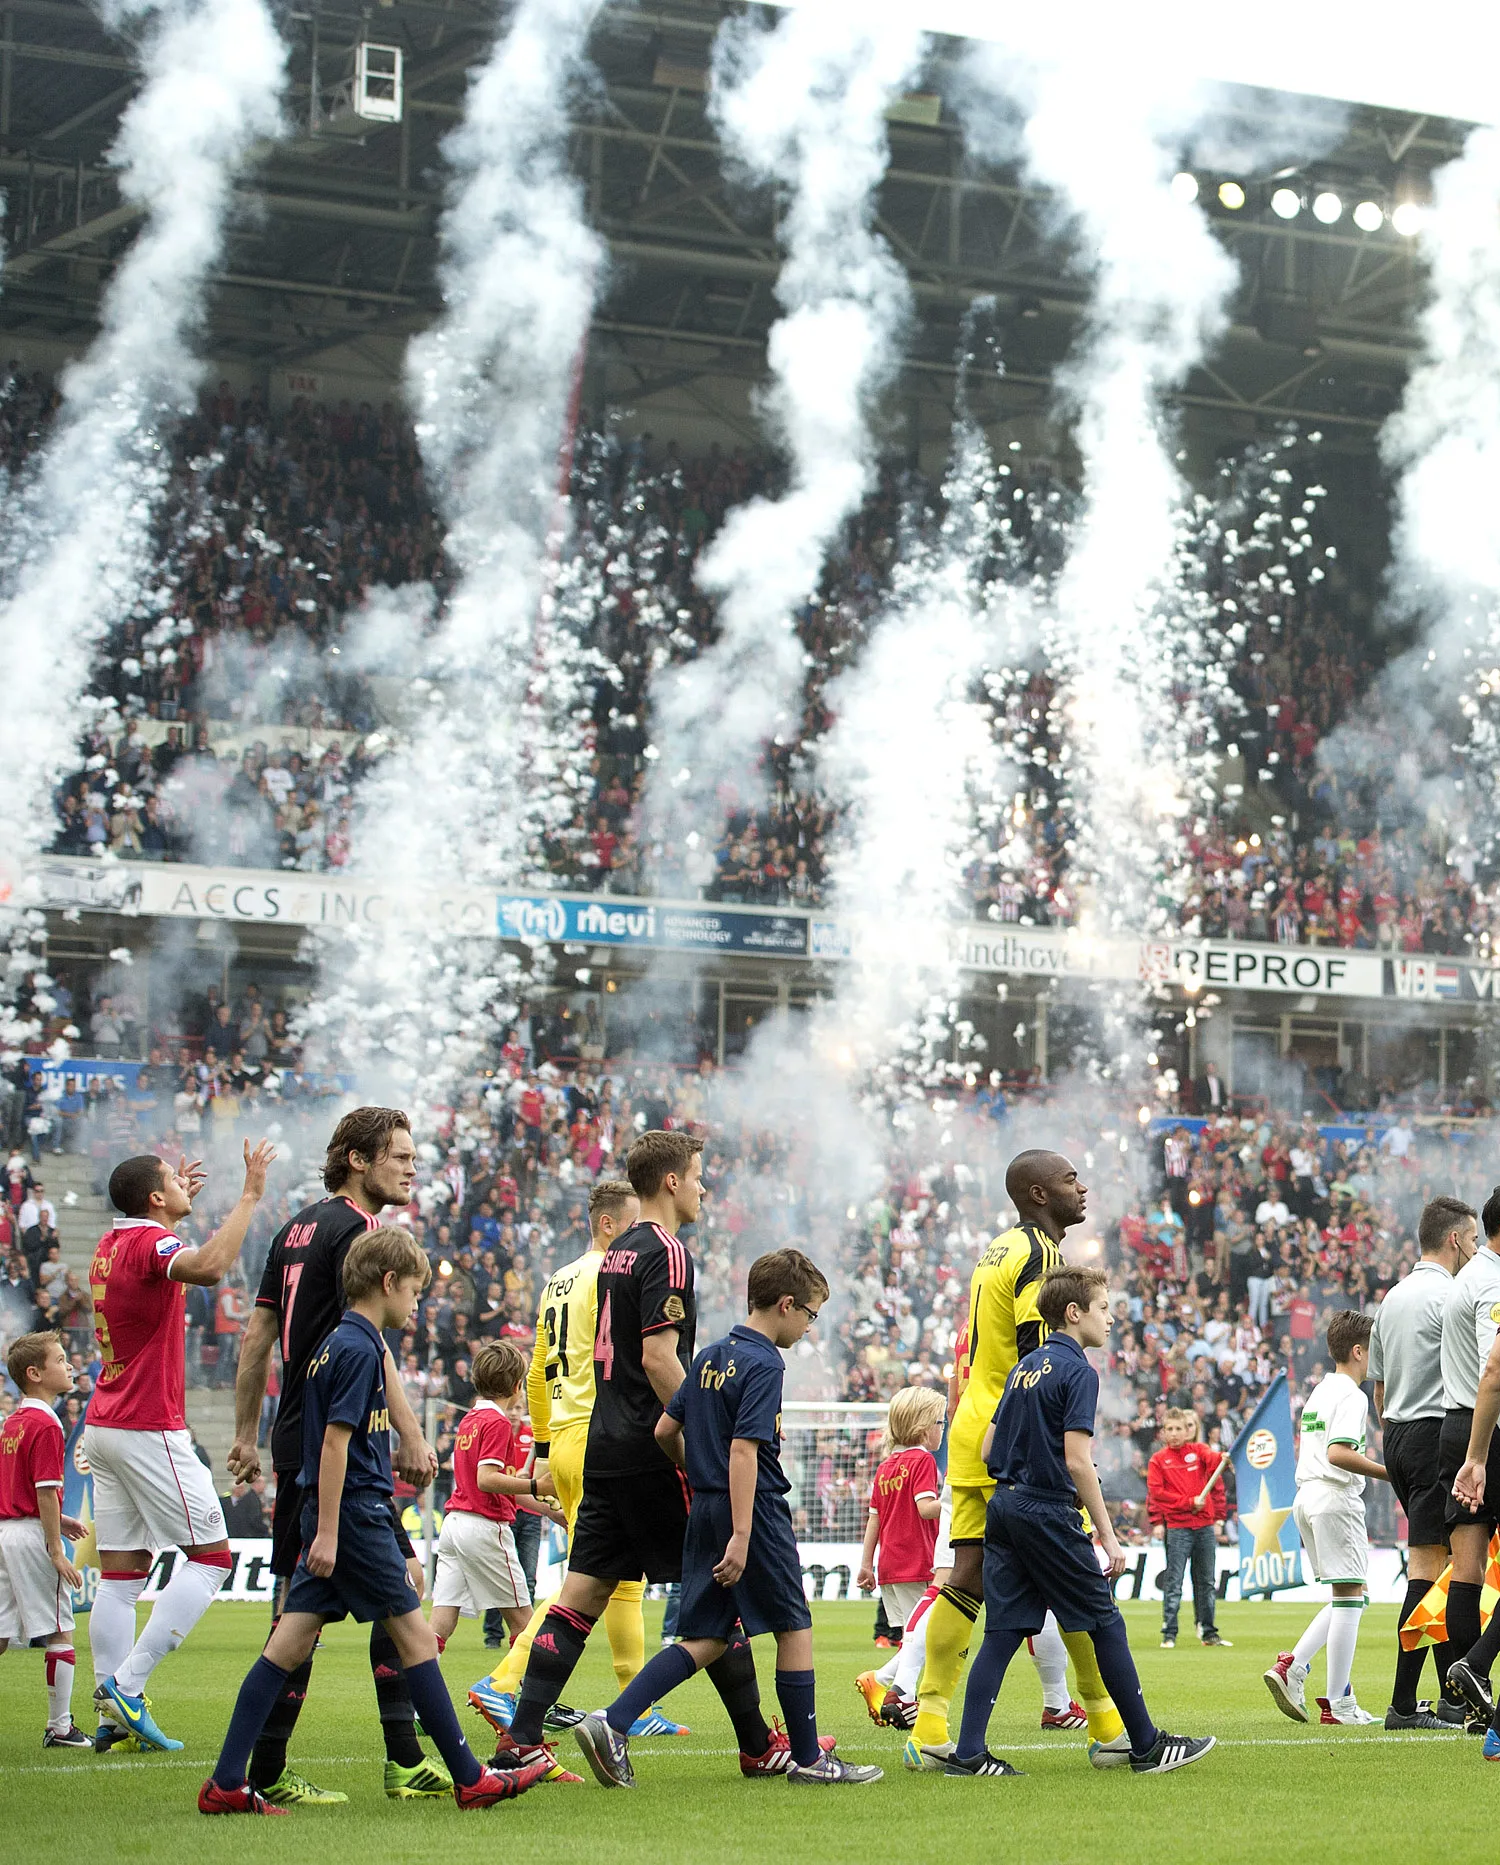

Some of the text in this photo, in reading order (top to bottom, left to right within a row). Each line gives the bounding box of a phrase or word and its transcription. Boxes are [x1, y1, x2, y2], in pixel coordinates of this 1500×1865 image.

[577, 902, 656, 938] mevi
[663, 915, 721, 930] ADVANCED
[663, 928, 732, 944] TECHNOLOGY
[1175, 950, 1347, 988] REPROF
[284, 1221, 318, 1248] BLIND
[546, 1275, 574, 1301] freo
[91, 1284, 115, 1362] 5
[281, 1262, 305, 1362] 17
[969, 1284, 982, 1367] 1
[543, 1302, 570, 1384] 21
[593, 1289, 614, 1381] 4
[1010, 1365, 1041, 1390] freo
[1241, 1550, 1297, 1592] 2007
